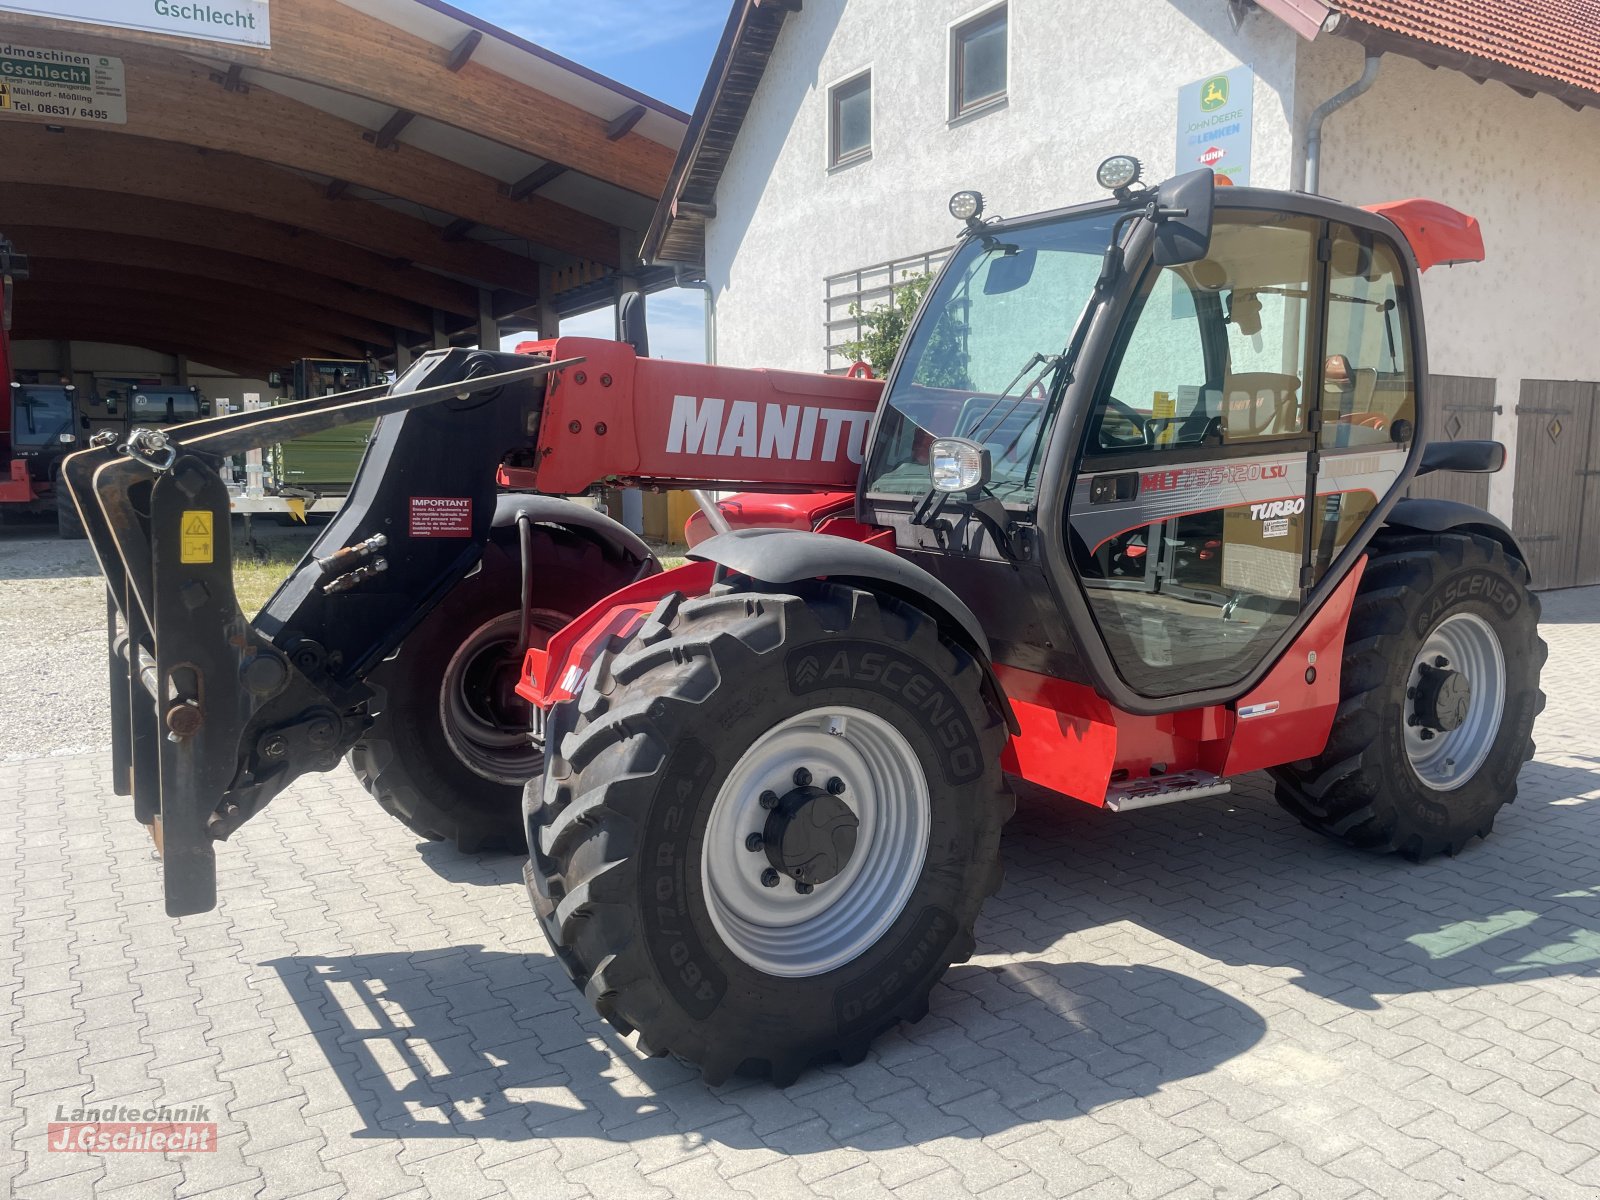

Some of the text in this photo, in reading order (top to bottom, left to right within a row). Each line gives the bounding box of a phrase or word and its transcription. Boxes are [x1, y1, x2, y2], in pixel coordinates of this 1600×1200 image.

[154, 0, 256, 29] Gschlecht
[1, 61, 87, 83] Gschlecht
[12, 101, 34, 112] Tel.
[80, 108, 108, 120] 6495
[1185, 109, 1244, 134] JOHN DEERE
[1197, 123, 1240, 144] LEMKEN
[1200, 149, 1225, 164] KUHN
[1140, 469, 1184, 493] MLT
[1260, 465, 1288, 480] LSU
[412, 499, 470, 507] IMPORTANT
[1250, 497, 1306, 521] TURBO
[1429, 576, 1518, 620] ASCENSO
[822, 651, 977, 778] ASCENSO
